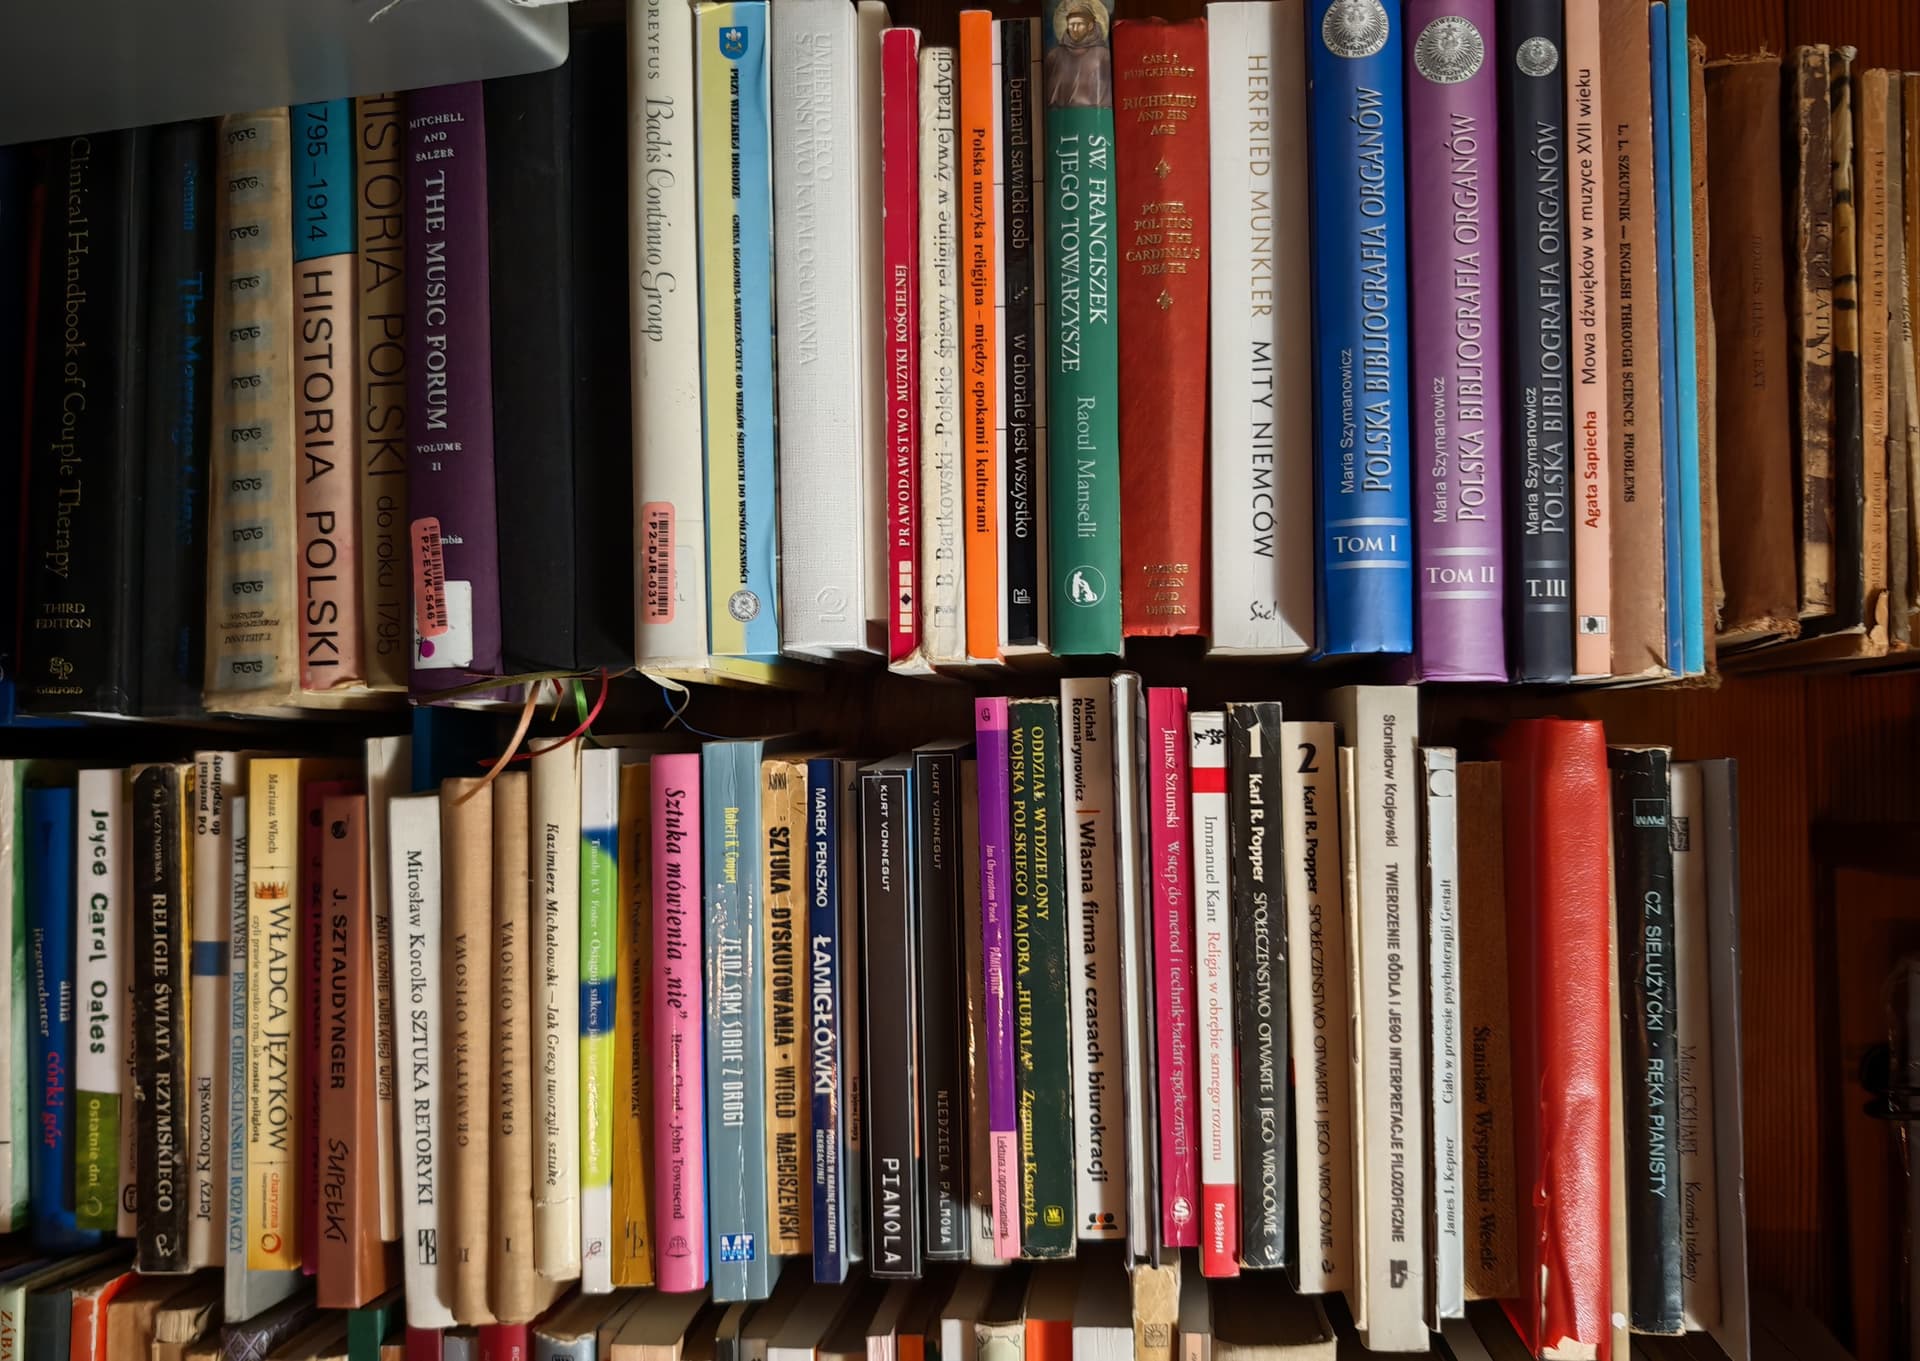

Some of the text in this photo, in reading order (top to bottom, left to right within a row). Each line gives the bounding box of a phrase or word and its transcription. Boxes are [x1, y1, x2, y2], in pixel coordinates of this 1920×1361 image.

[409, 113, 464, 128] MITCHELL
[424, 132, 447, 143] AND
[931, 51, 954, 121] tradycji
[1137, 111, 1164, 122] AND
[1151, 124, 1176, 135] AGE
[69, 138, 91, 225] Clinical
[416, 148, 455, 161] SALZER
[731, 153, 741, 199] DRODZE
[1056, 150, 1081, 374] JEGO TOWARZYSZE
[1088, 135, 1111, 325] ŚW. FRANCISZEK
[1136, 233, 1162, 246] AND
[425, 170, 448, 430] THE MUSIC FORUM
[640, 270, 677, 342] Group
[970, 128, 990, 533] Polska muzyka religijna między epokami kulturami
[1010, 78, 1032, 538] bernard sawicki chorale wszystko
[1248, 55, 1279, 558] HERFRIED MÜNKLER MITY NIEMCÓW
[1350, 86, 1392, 492] POLSKA BIBLIOGRAFIA ORGANÓW
[1444, 113, 1487, 522] POLSKA BIBLIOGRAFIA ORGANÓW
[1531, 120, 1565, 534] POLSKA BIBLIOGRAFIA ORGANÓW
[1575, 68, 1600, 528] Agata Sapiecha Mowa dźwięków muzyce XVII wieku
[1618, 155, 1635, 502] SZKUTNIK ENGLISH THROUGH PROBLEMS
[366, 314, 406, 477] POLSKI
[416, 442, 462, 453] VOLUME
[893, 264, 911, 547] PRAWODAWSTWO MUZYKI KOŚCIELNEJ
[1338, 348, 1354, 493] Maria Szymanowicz
[1431, 377, 1449, 524] Maria Szymanowicz
[303, 271, 339, 667] HISTORIA POLSKI
[1076, 395, 1097, 538] Raoul Manselli
[1523, 386, 1541, 536] Maria Szymanowicz
[1332, 536, 1384, 554] TOM
[1425, 567, 1474, 584] TOM
[1071, 698, 1086, 801] Rozmarynowicz
[1084, 698, 1097, 742] Michał
[1161, 728, 1178, 769] Janusz
[1246, 722, 1263, 758] 1
[1297, 741, 1319, 774] 2
[197, 816, 208, 836] Od
[210, 820, 221, 836] do
[268, 773, 279, 817] Mariusz
[724, 807, 741, 838] Robert
[880, 784, 890, 892] KURT VONNEGUT
[932, 800, 942, 871] VONNEGUT
[1303, 786, 1319, 895] Karl Popper
[546, 823, 560, 987] Kazimierz Michałowski
[1010, 727, 1031, 975] WOJSKA POLSKIEGO MAJORA
[1034, 807, 1050, 921] WYDZIELONY
[1206, 889, 1220, 923] Kant
[233, 873, 247, 960] TARNAWSKI
[664, 788, 687, 1154] Sztuka mówienia John
[811, 787, 835, 1095] MAREK PENSZKO ŁAMIGŁÓWKI
[1247, 773, 1276, 1093] Karl Popper SPOŁECZEŃSTWO OTWARTE
[88, 981, 110, 1053] Oates
[263, 904, 293, 1152] WŁADCA JĘZYKÓW
[330, 914, 347, 1089] SZTAUDYNGER
[407, 850, 434, 1206] Mirosław Korolko SZTUKA RETORYKI
[590, 988, 603, 1026] sukces
[769, 826, 800, 1239] SZTUKA DYSKUTOWANIA MARCISZEWSKI
[1079, 820, 1109, 1182] Własna firma czasach biurokracji
[1382, 714, 1405, 1243] Stanisław Krajewski TWIERDZENIE INTERPRETACJE FILOZOFICZNE
[152, 893, 173, 1213] RELIGIE ŚWIATA RZYMSKIEGO
[454, 1029, 470, 1149] GRAMATYKA
[501, 1015, 515, 1137] GRAMATYKA
[723, 1082, 745, 1126] DROGI
[1645, 925, 1667, 1198] SIELUŻYCKI PIANISTY
[196, 1077, 212, 1172] Kłoczowski
[937, 1089, 951, 1172] NIEDZIELA
[882, 1158, 902, 1264] PIANOLA
[1444, 1198, 1457, 1238] James
